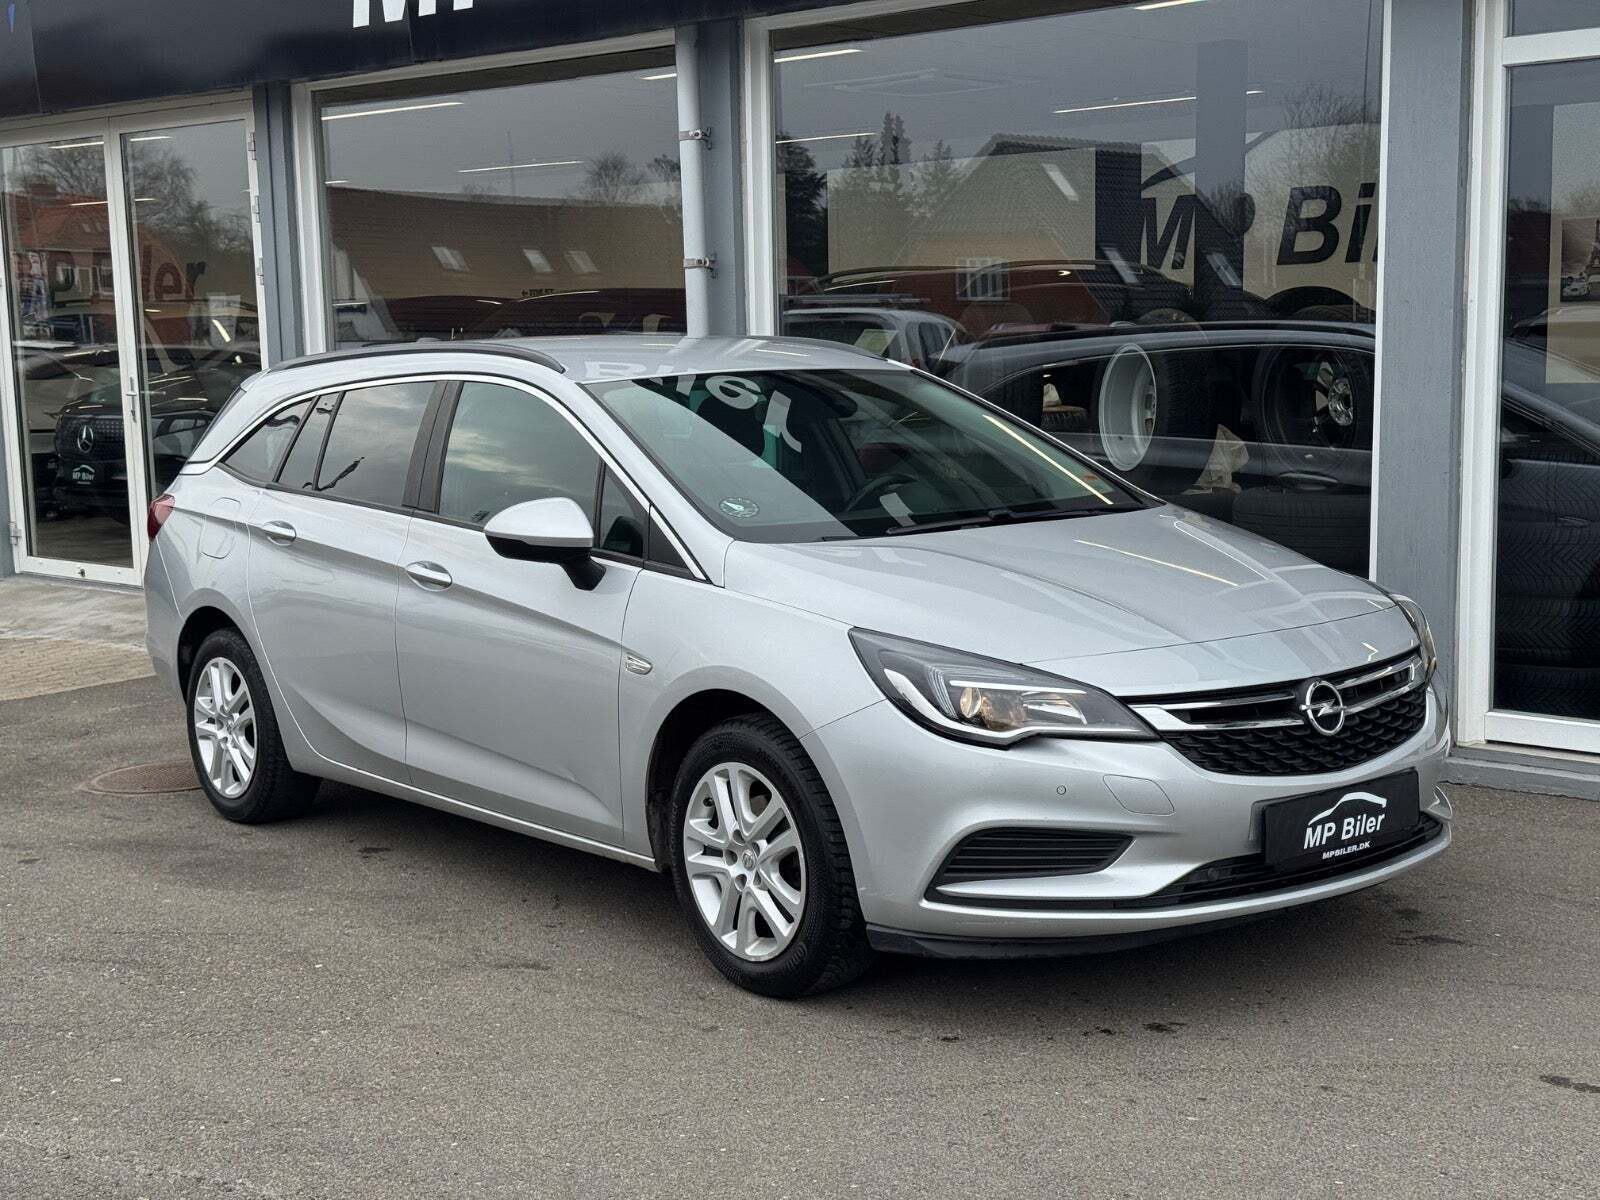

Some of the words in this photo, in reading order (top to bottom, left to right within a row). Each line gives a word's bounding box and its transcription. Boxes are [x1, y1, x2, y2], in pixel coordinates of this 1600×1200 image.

[1276, 183, 1378, 265] Bi
[1303, 822, 1336, 849] MP
[1341, 813, 1385, 840] Biler
[1322, 841, 1371, 859] MPBILER.DK
